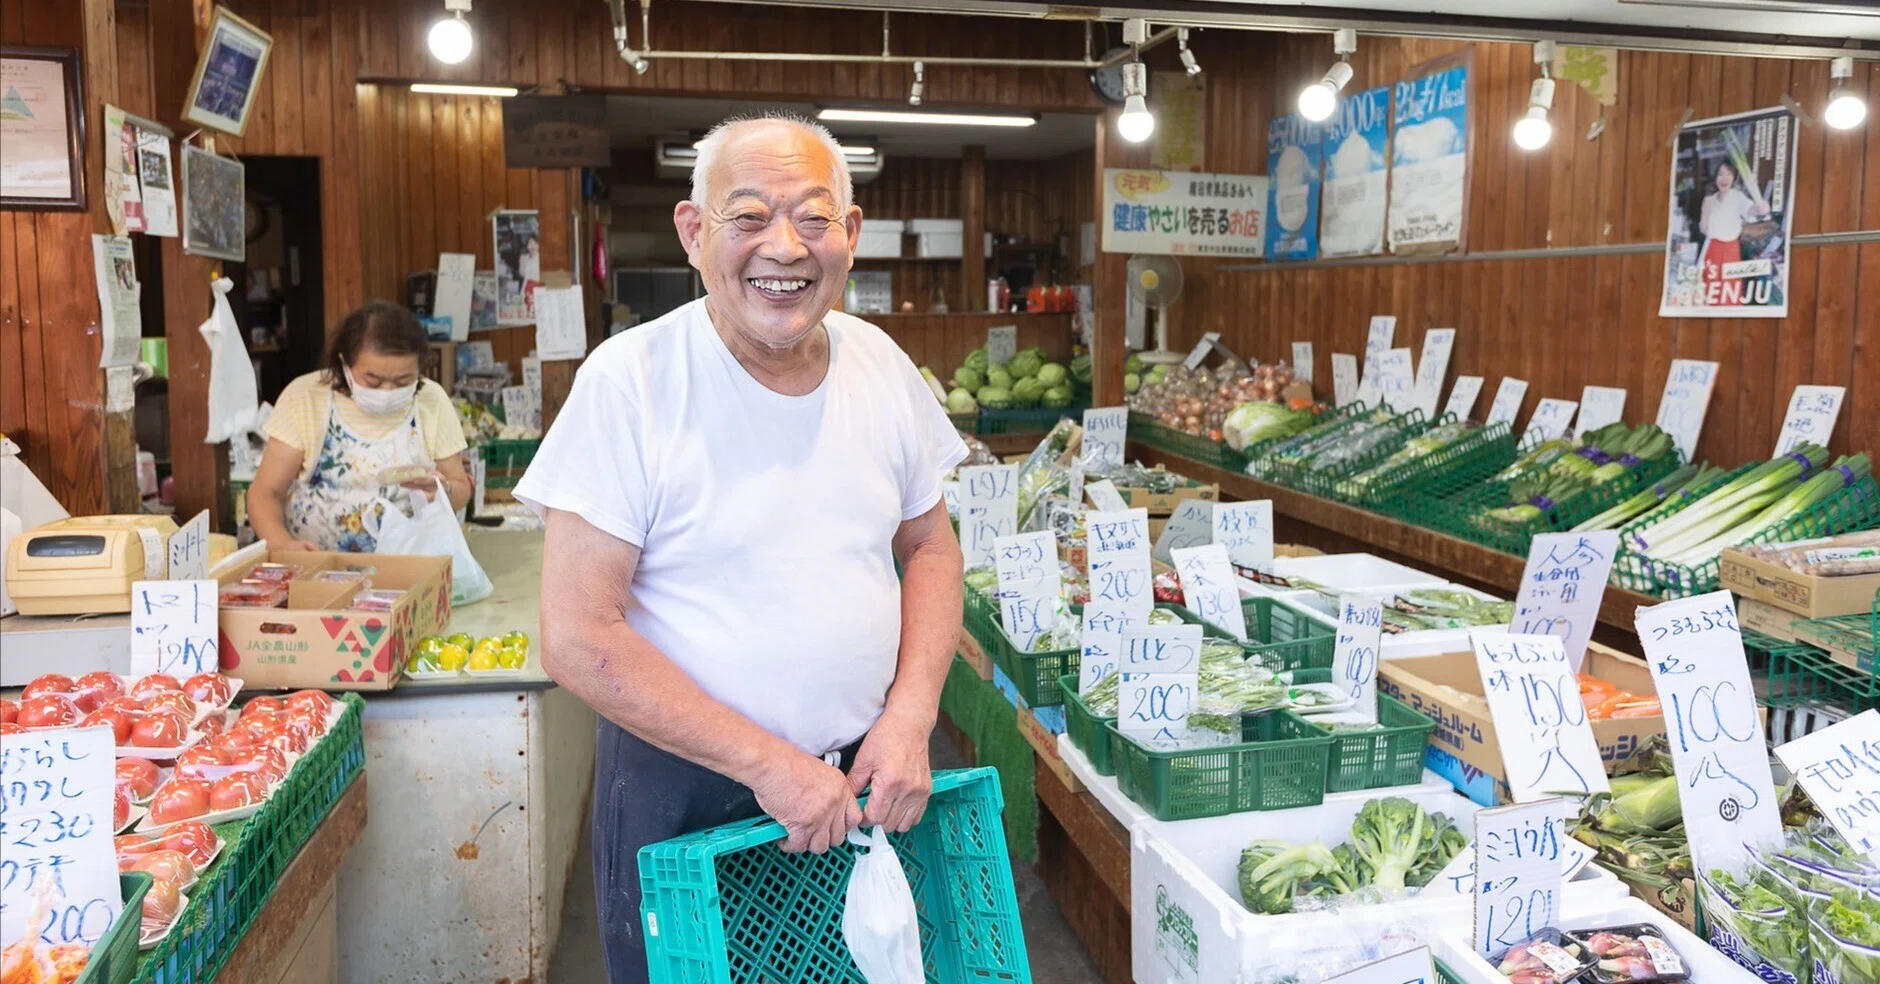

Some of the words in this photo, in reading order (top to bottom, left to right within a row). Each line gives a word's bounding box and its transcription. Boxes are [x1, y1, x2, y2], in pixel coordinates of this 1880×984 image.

[1113, 203, 1261, 237] 健康やさいを売るお店
[142, 583, 213, 624] トマト
[1099, 569, 1146, 602] 200
[1196, 588, 1235, 618] 130
[1346, 647, 1375, 685] 100
[1129, 683, 1191, 722] 200
[1520, 673, 1584, 727] 150
[1672, 681, 1757, 752] 100
[12, 810, 94, 847] 230
[40, 897, 114, 946] 200
[1487, 889, 1553, 952] 120
